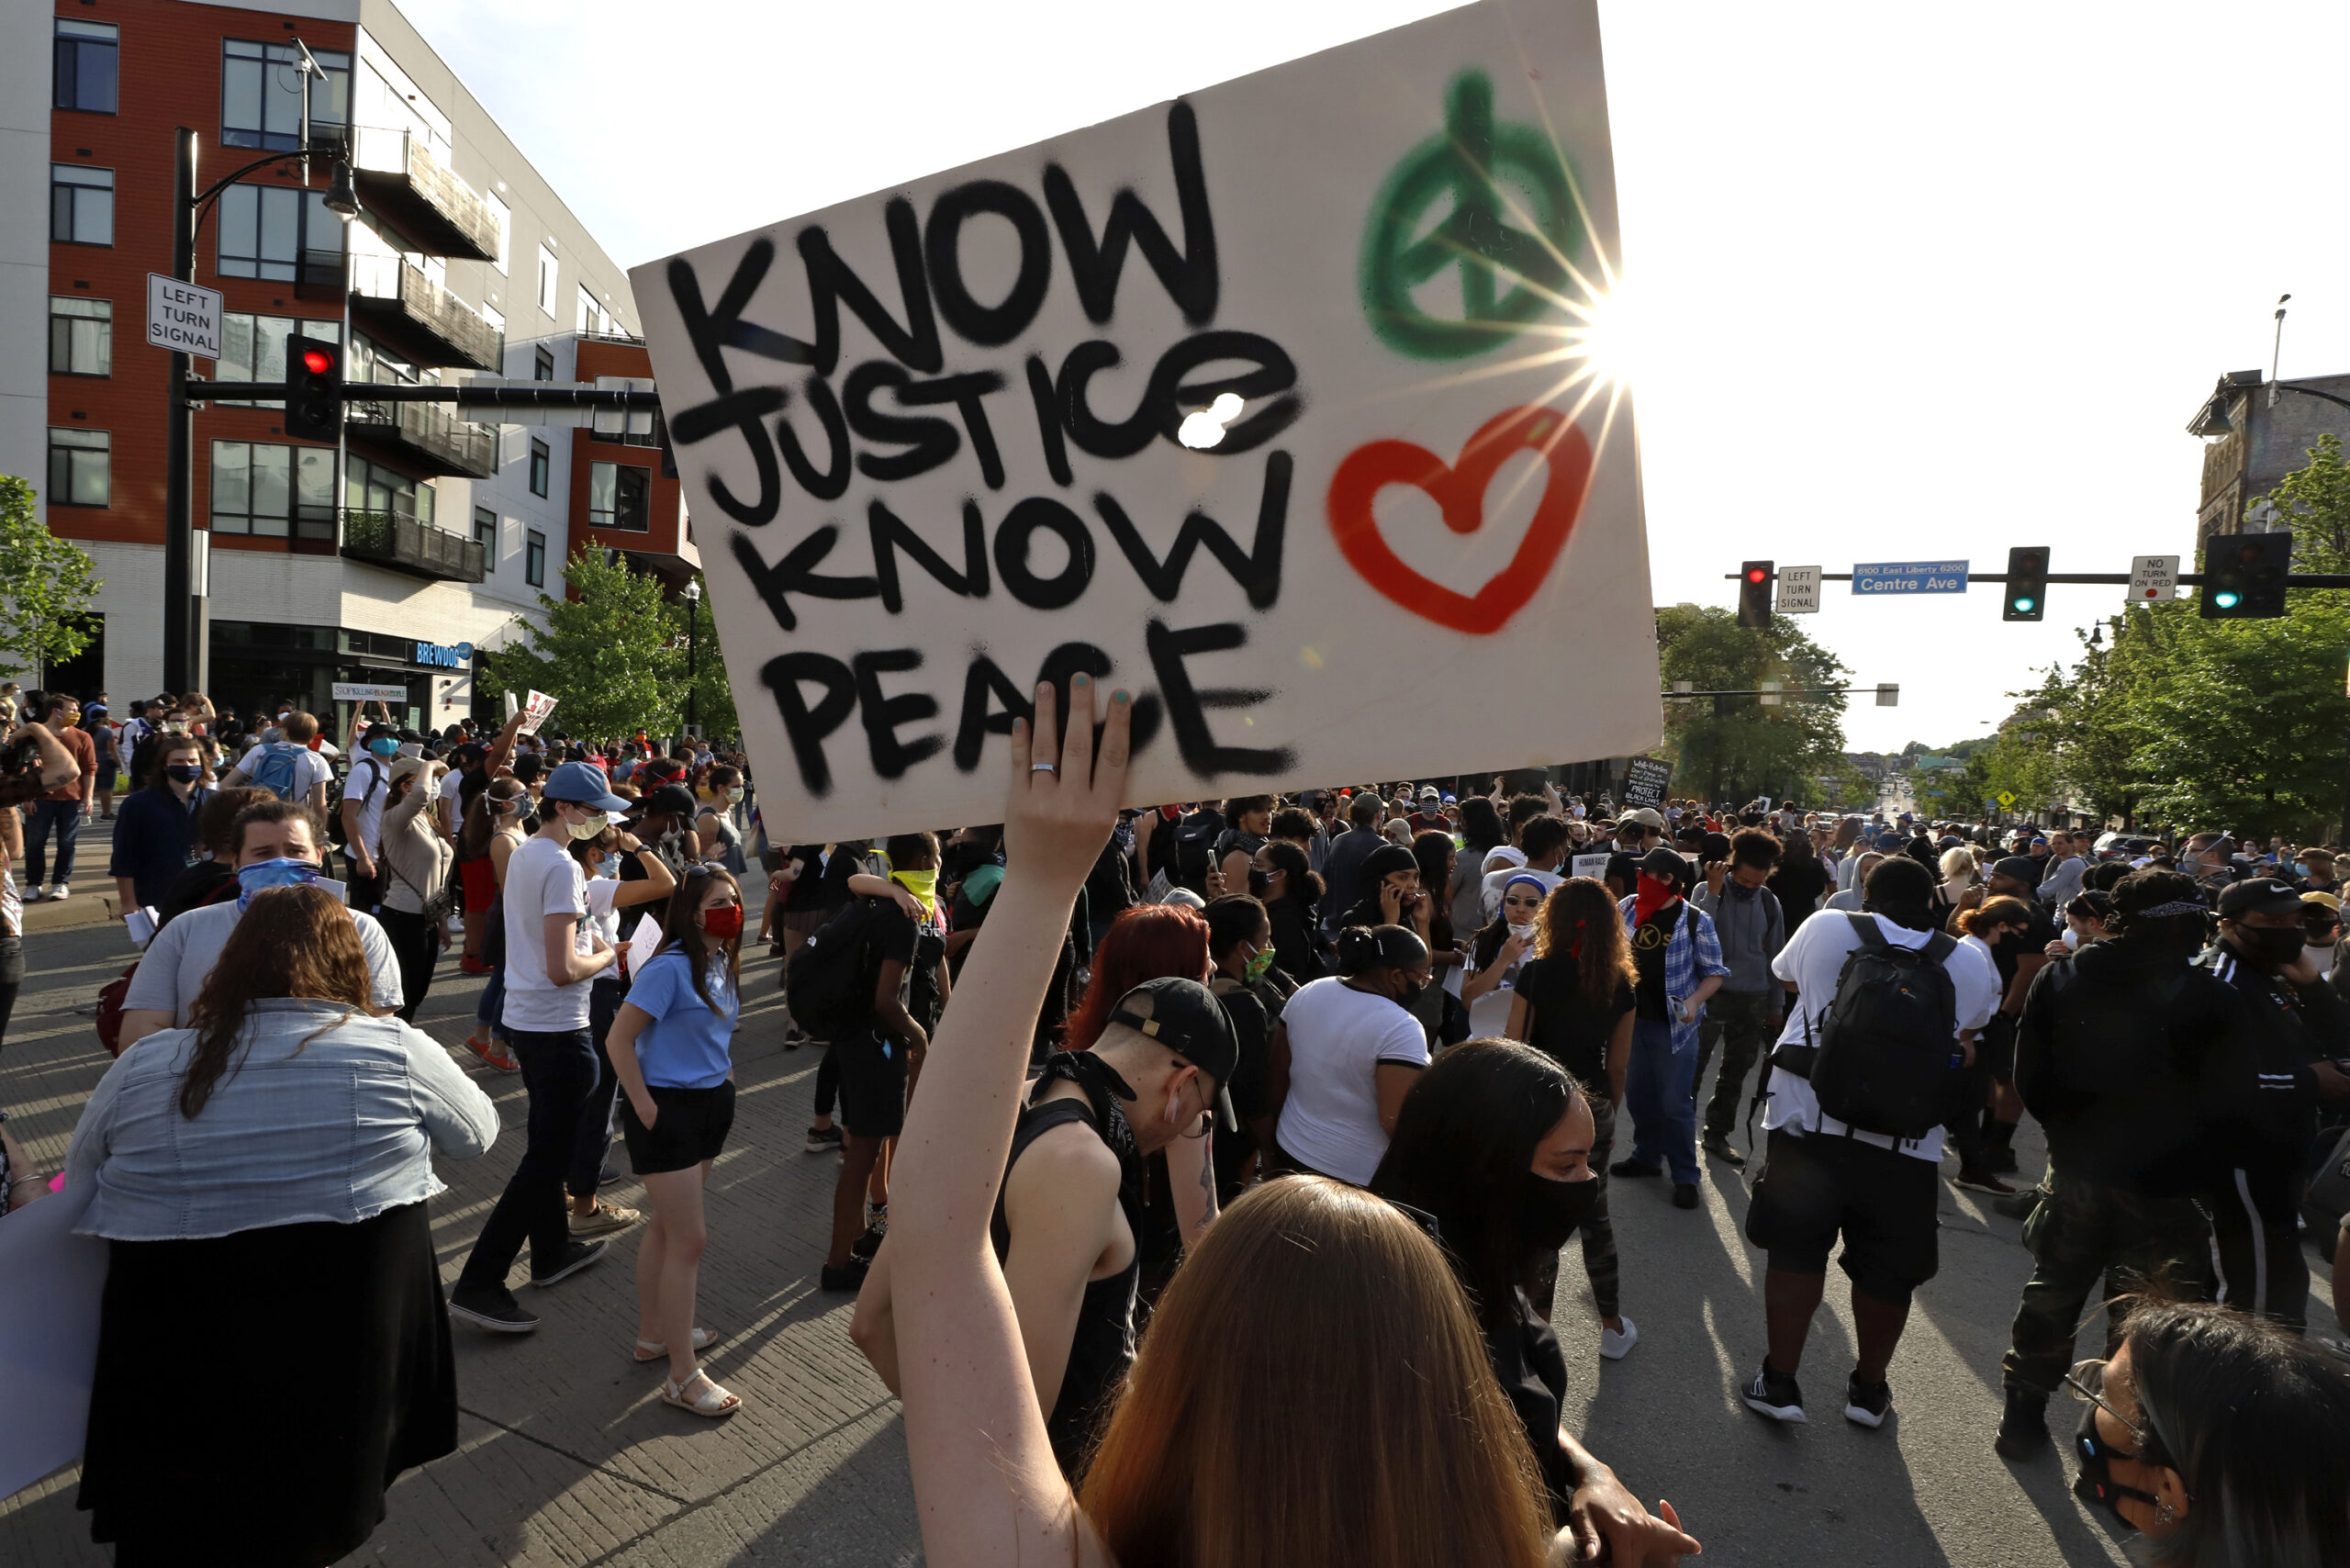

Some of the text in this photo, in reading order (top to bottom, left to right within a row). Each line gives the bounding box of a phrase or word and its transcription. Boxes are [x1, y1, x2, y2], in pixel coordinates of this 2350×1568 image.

[667, 99, 1221, 397] KNOW
[163, 286, 208, 308] LEFT
[162, 305, 210, 330] TURN
[151, 323, 218, 352] SIGNAL
[729, 449, 1295, 632] KNOW
[2147, 559, 2164, 568] NO
[1788, 571, 1811, 581] LEFT
[1858, 566, 1880, 575] 6100
[1906, 566, 1937, 574] Liberty
[1786, 585, 1811, 594] TURN
[1861, 577, 1958, 591] Centre Ave
[1781, 598, 1815, 608] SIGNAL
[417, 642, 459, 667] BREWDOG
[335, 686, 352, 696] STOP
[1631, 785, 1661, 798] PROTECT
[1625, 792, 1644, 801] BLACK
[1645, 796, 1661, 806] LIVES
[1578, 857, 1606, 867] HUMAN RACE
